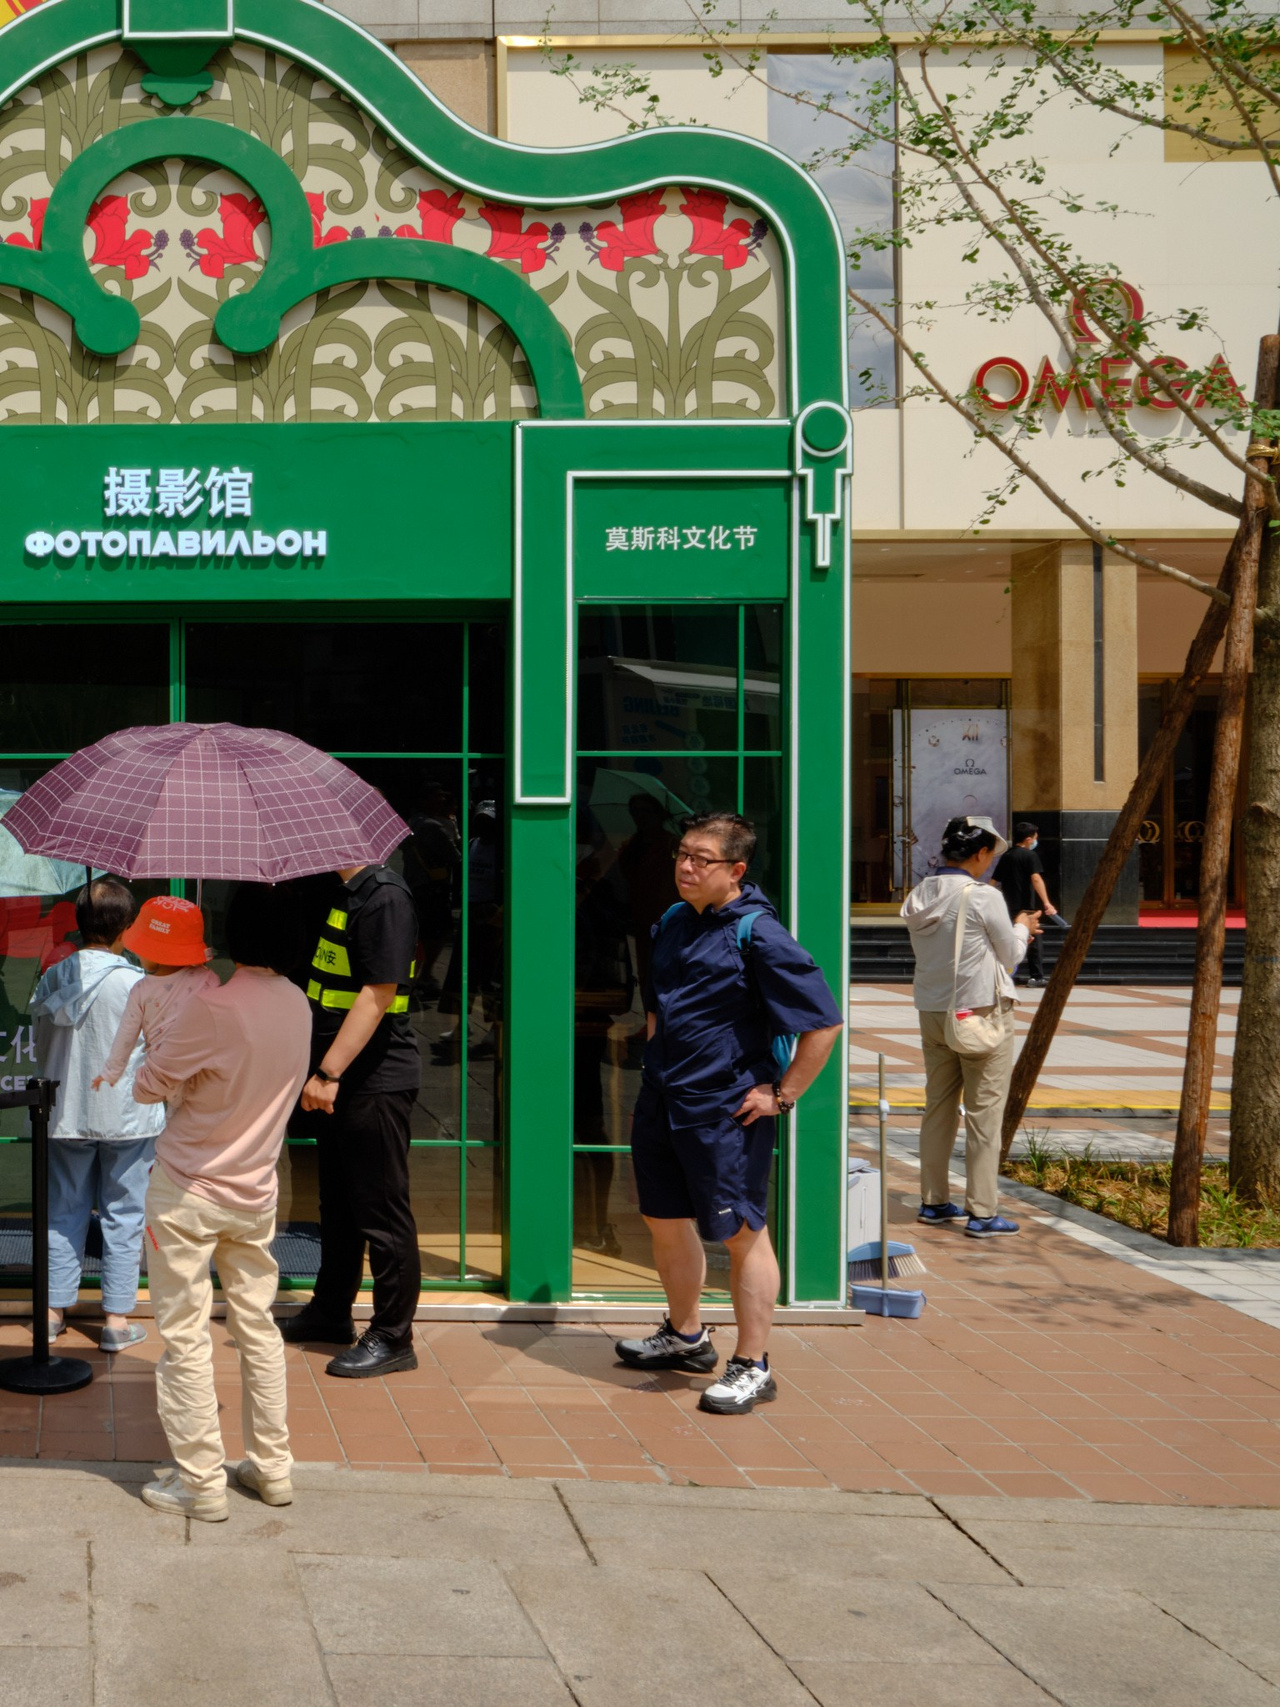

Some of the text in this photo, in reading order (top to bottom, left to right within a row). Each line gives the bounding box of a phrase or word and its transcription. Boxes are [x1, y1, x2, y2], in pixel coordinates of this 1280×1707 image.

[973, 353, 1250, 412] OMEGA
[104, 467, 253, 518] 摄影馆
[24, 529, 327, 558] ФОТОПАВИЛЬОН
[605, 525, 758, 551] 莫斯科文化节
[953, 767, 987, 776] OMEGA
